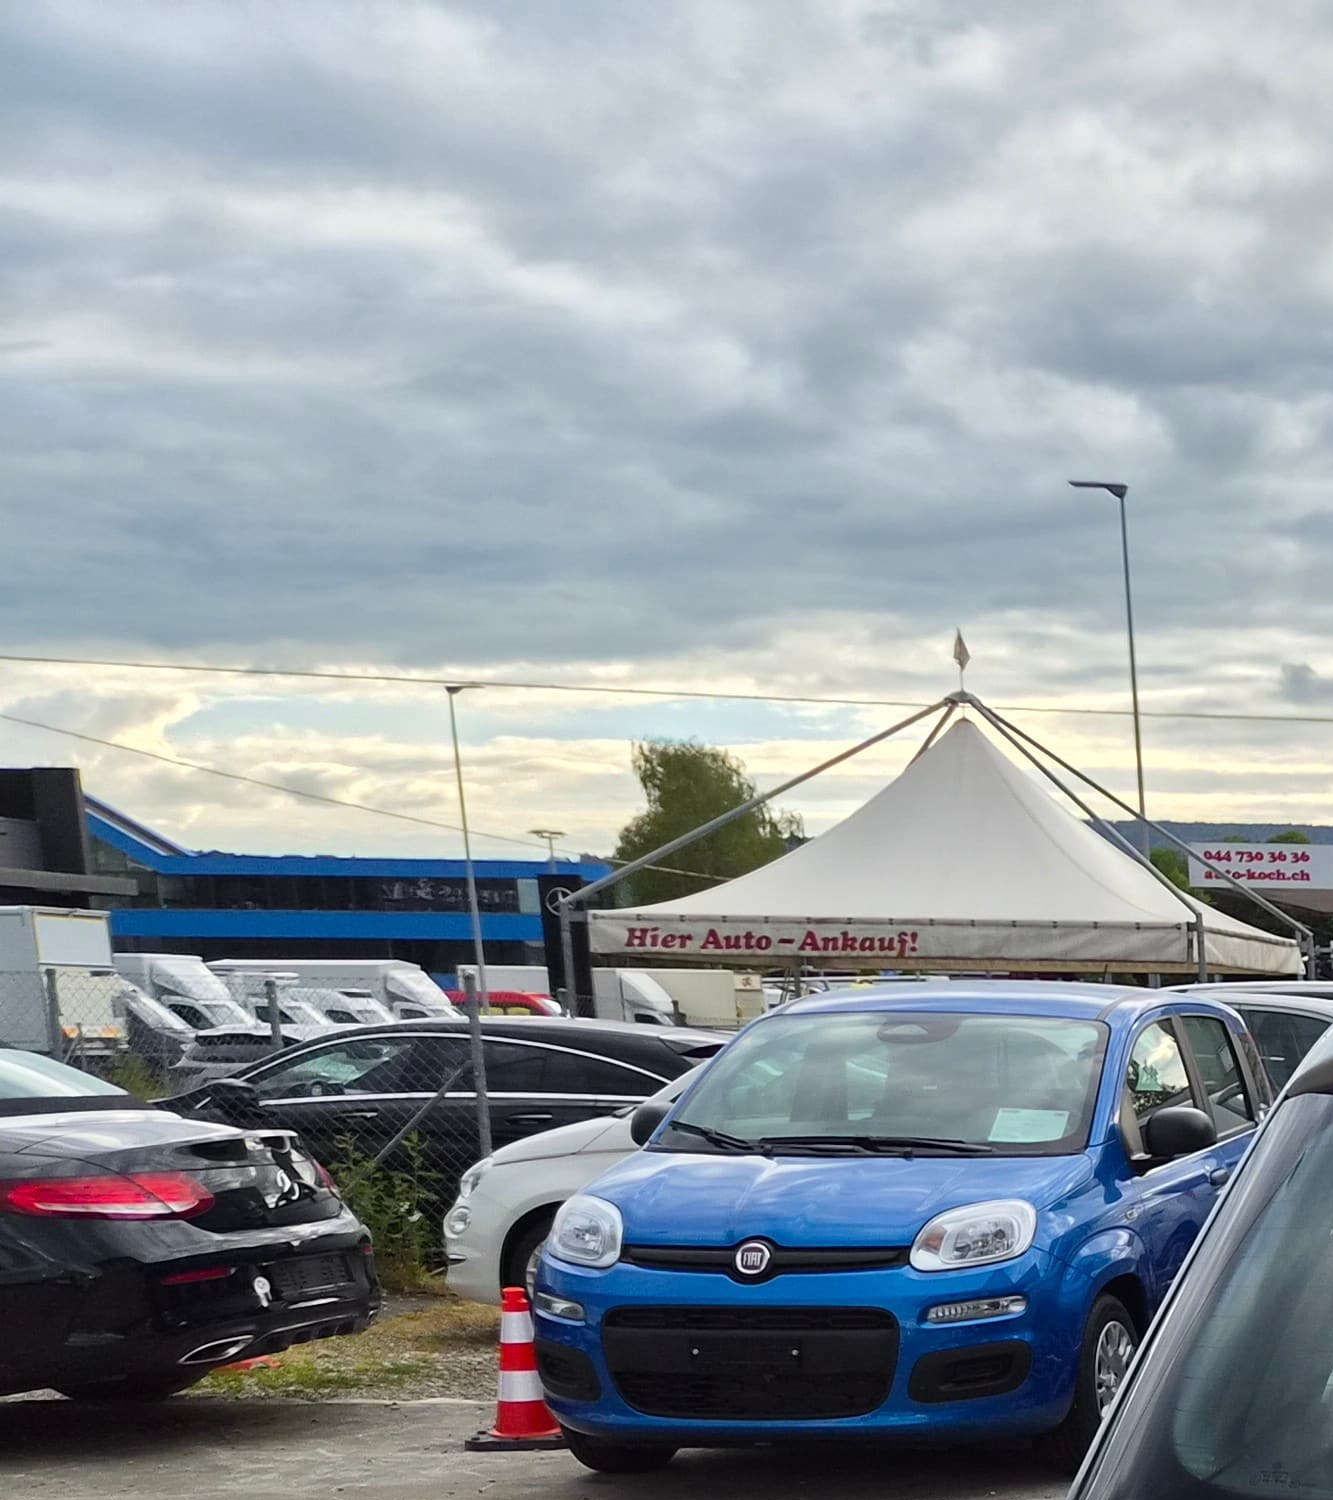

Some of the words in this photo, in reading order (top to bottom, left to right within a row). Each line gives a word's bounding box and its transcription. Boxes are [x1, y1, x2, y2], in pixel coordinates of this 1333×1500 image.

[1203, 850, 1232, 862] 044
[1235, 850, 1264, 864] 730
[1268, 850, 1287, 864] 36
[1291, 850, 1310, 863] 36
[624, 927, 693, 949] Hier
